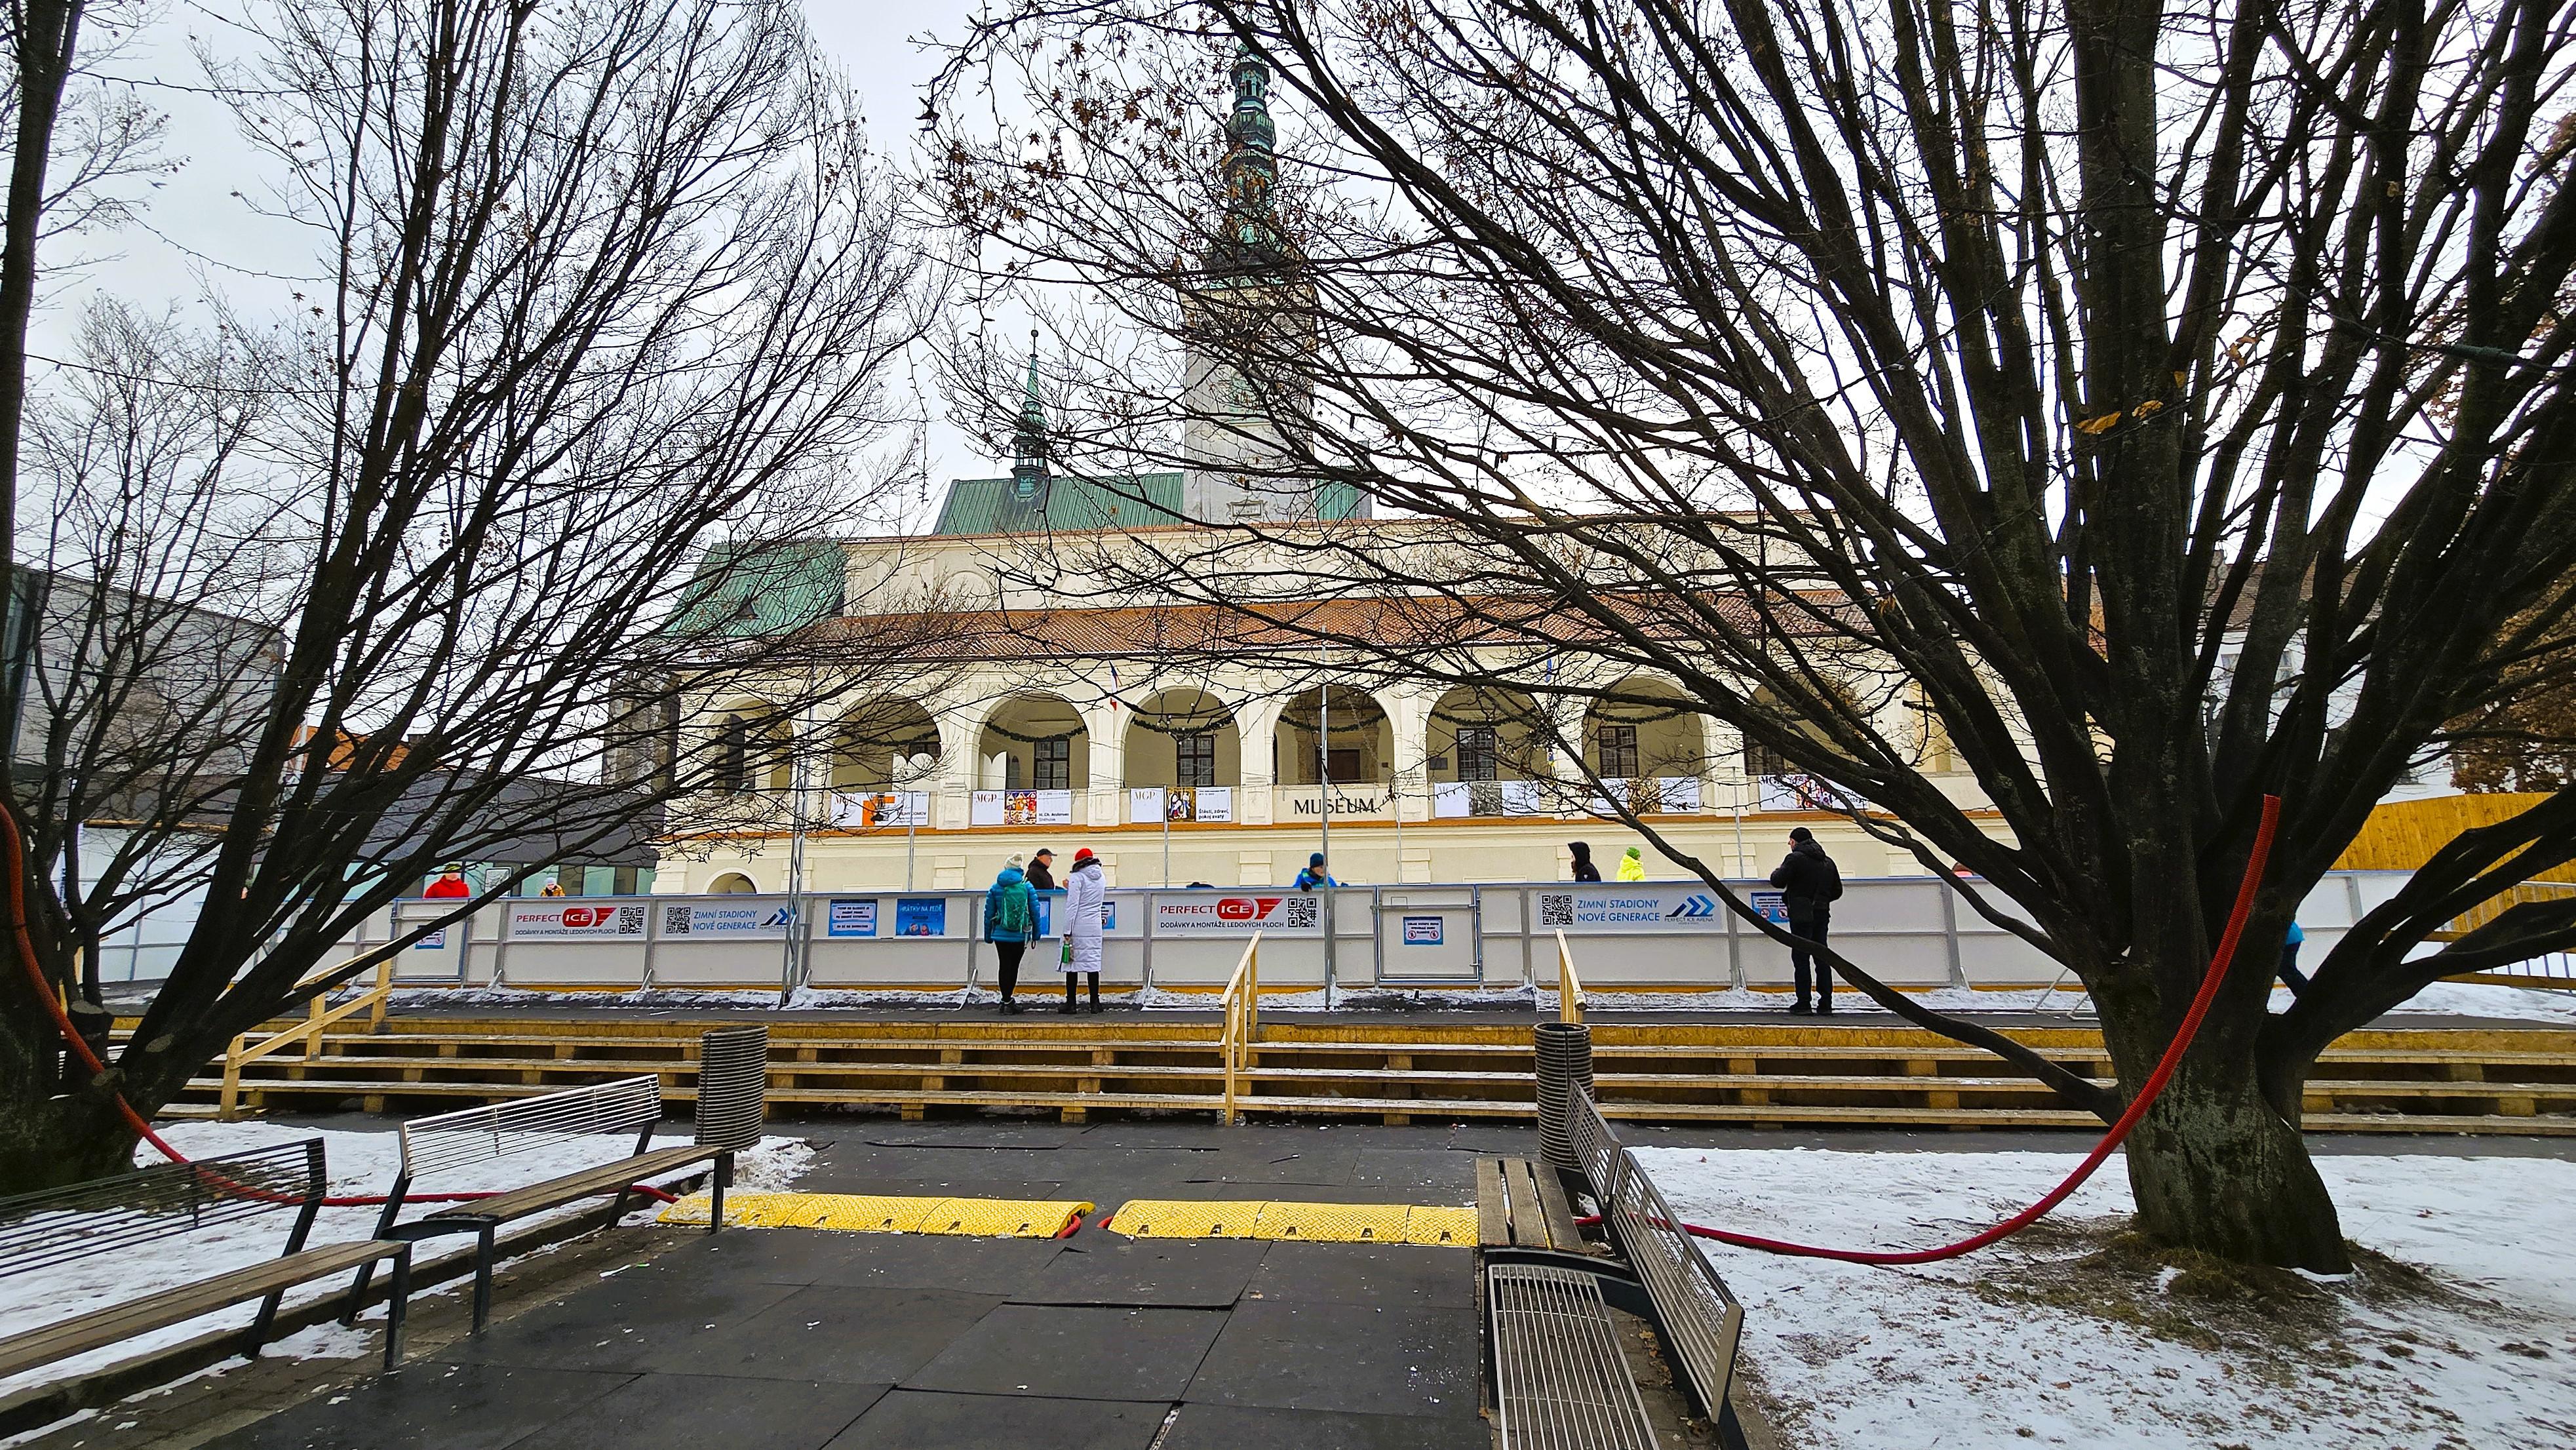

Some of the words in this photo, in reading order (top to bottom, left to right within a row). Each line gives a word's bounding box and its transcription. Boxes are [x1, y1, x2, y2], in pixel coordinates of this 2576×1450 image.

[976, 793, 997, 803] MGP
[1134, 791, 1156, 800] MGP
[1294, 798, 1374, 814] MUSEUM
[1577, 899, 1607, 909] ZIMNÍ
[1609, 899, 1659, 909] STADIONY
[693, 909, 717, 919] ZIMNÍ
[719, 910, 758, 918] STADIONY
[1160, 905, 1216, 914] PERFECT
[1221, 905, 1250, 913] ICE
[1577, 911, 1605, 921] NOVÉ
[1609, 912, 1660, 921] GENERACE
[693, 920, 715, 930] NOVÉ
[716, 921, 756, 930] GENERACE
